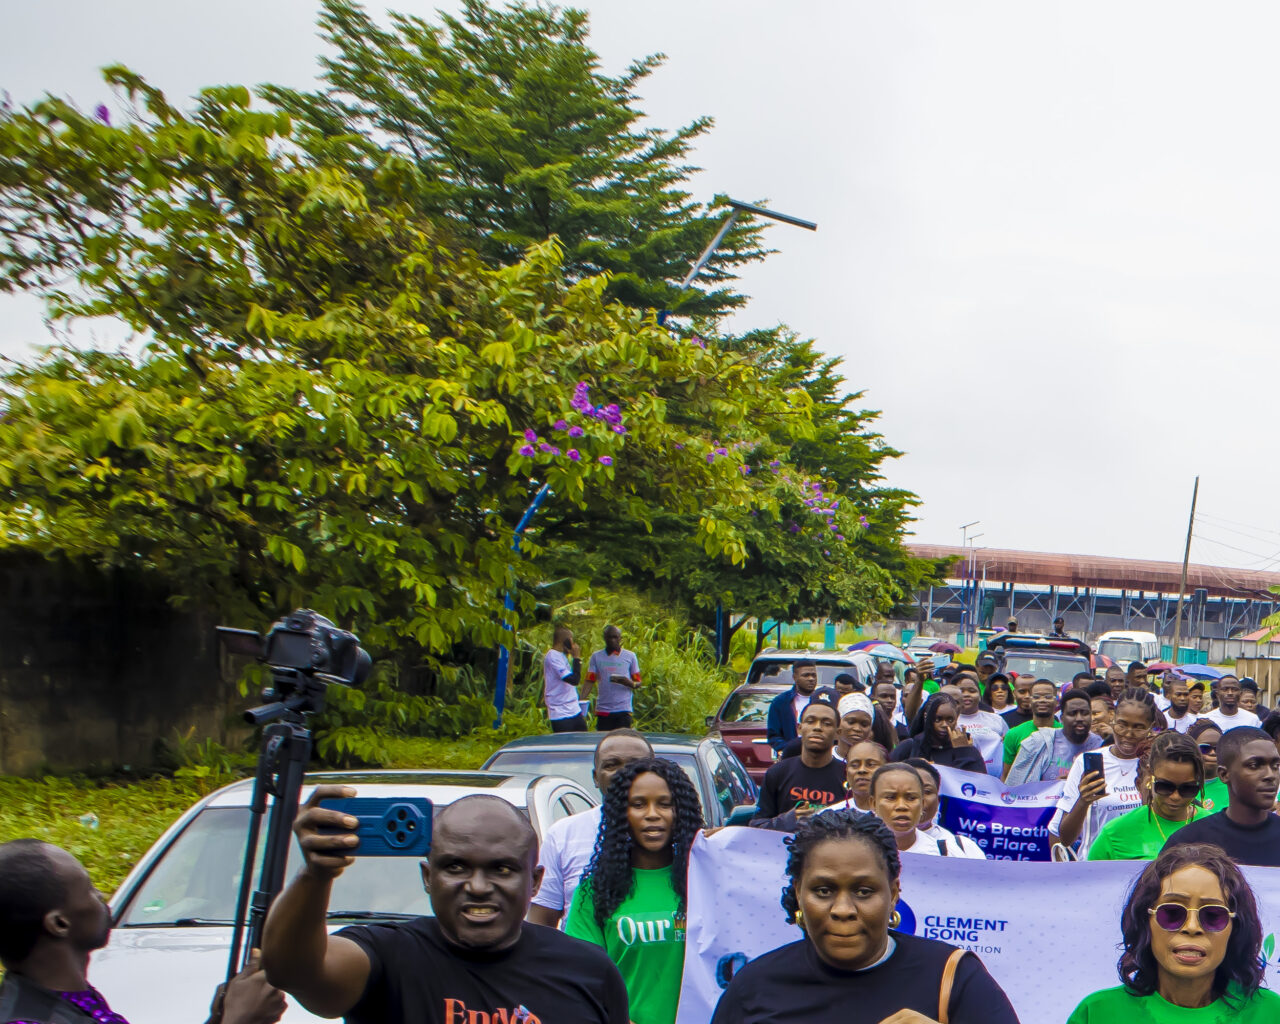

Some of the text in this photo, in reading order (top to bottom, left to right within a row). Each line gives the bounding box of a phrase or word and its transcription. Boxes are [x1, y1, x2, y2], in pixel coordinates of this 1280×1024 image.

[790, 786, 835, 804] Stop
[958, 817, 1049, 837] We Breath
[993, 837, 1040, 852] Flare.
[617, 916, 670, 946] Our
[924, 915, 1008, 932] CLEMENT
[923, 927, 979, 942] ISONG
